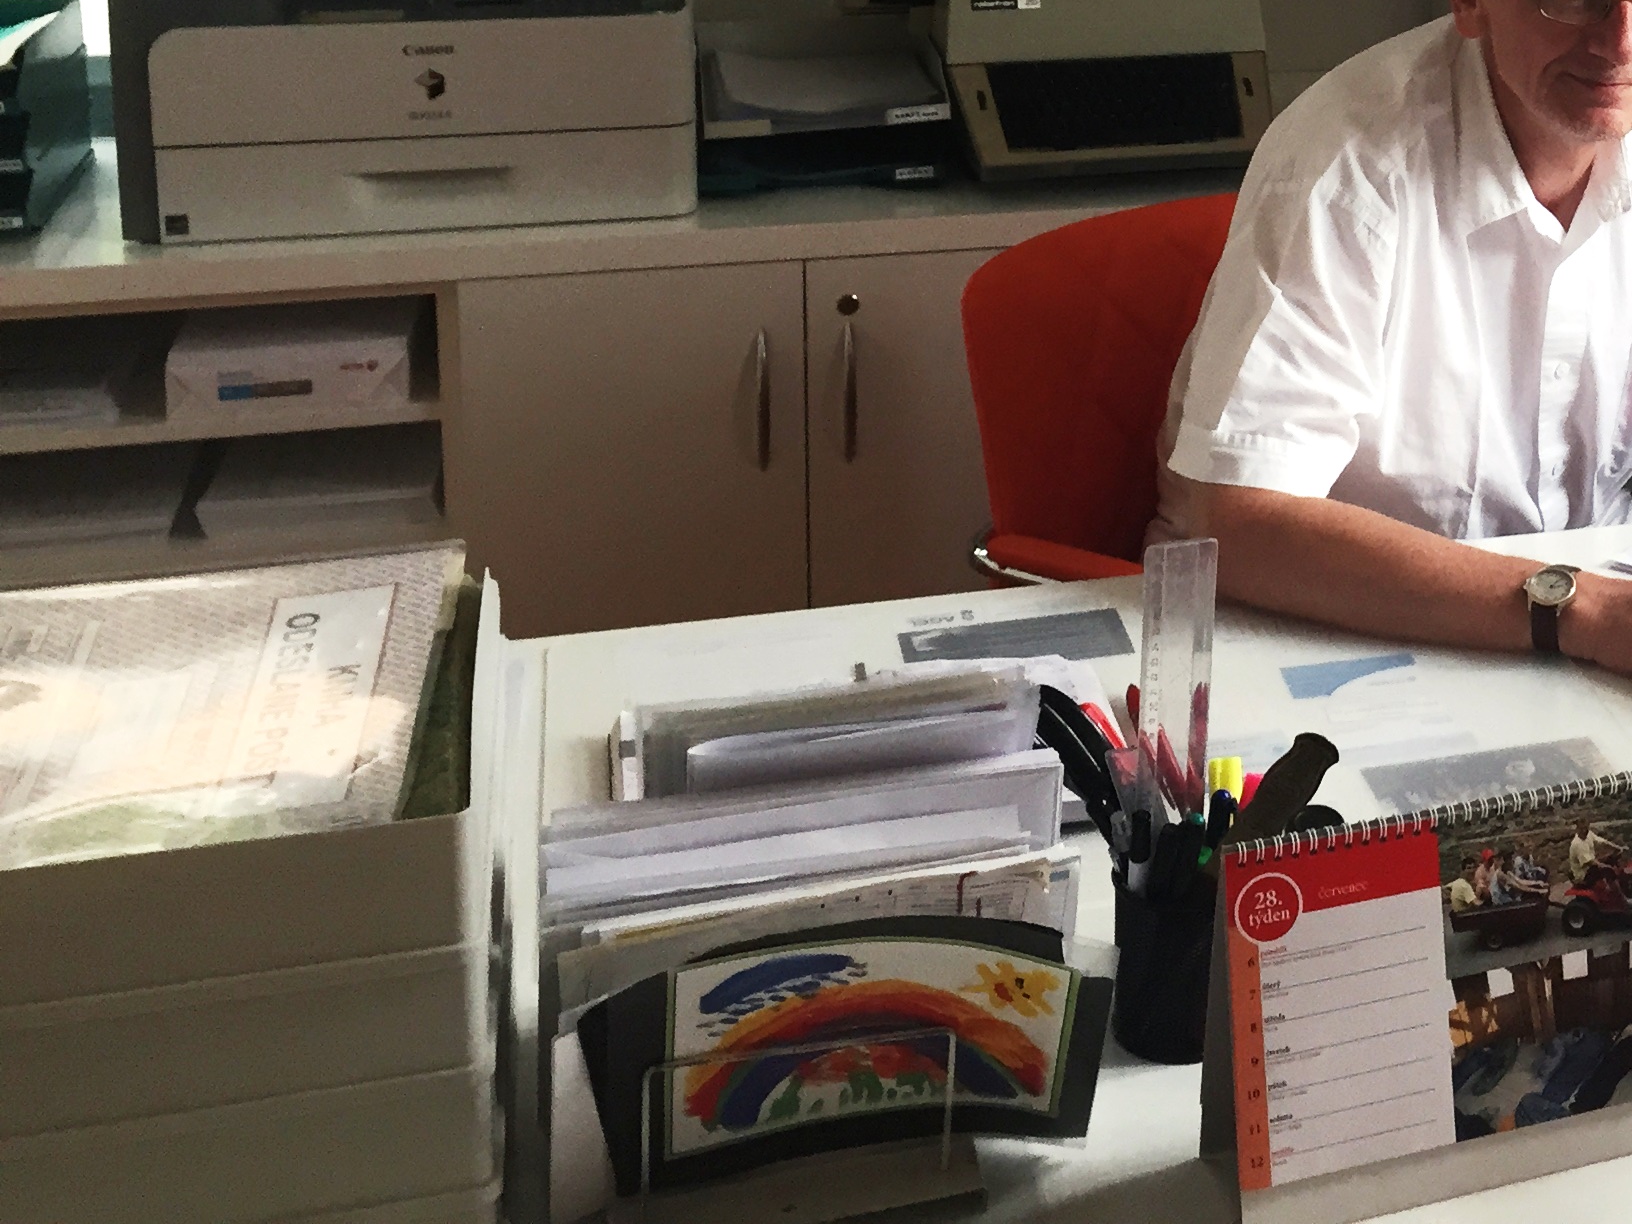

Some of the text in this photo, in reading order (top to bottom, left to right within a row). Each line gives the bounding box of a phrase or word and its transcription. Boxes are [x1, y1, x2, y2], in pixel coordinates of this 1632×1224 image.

[401, 44, 455, 56] Canon
[1254, 888, 1283, 910] 28.
[1248, 908, 1290, 930] týden
[1247, 1089, 1260, 1101] 10
[1249, 1123, 1260, 1135] 11
[1250, 1156, 1264, 1169] 12
